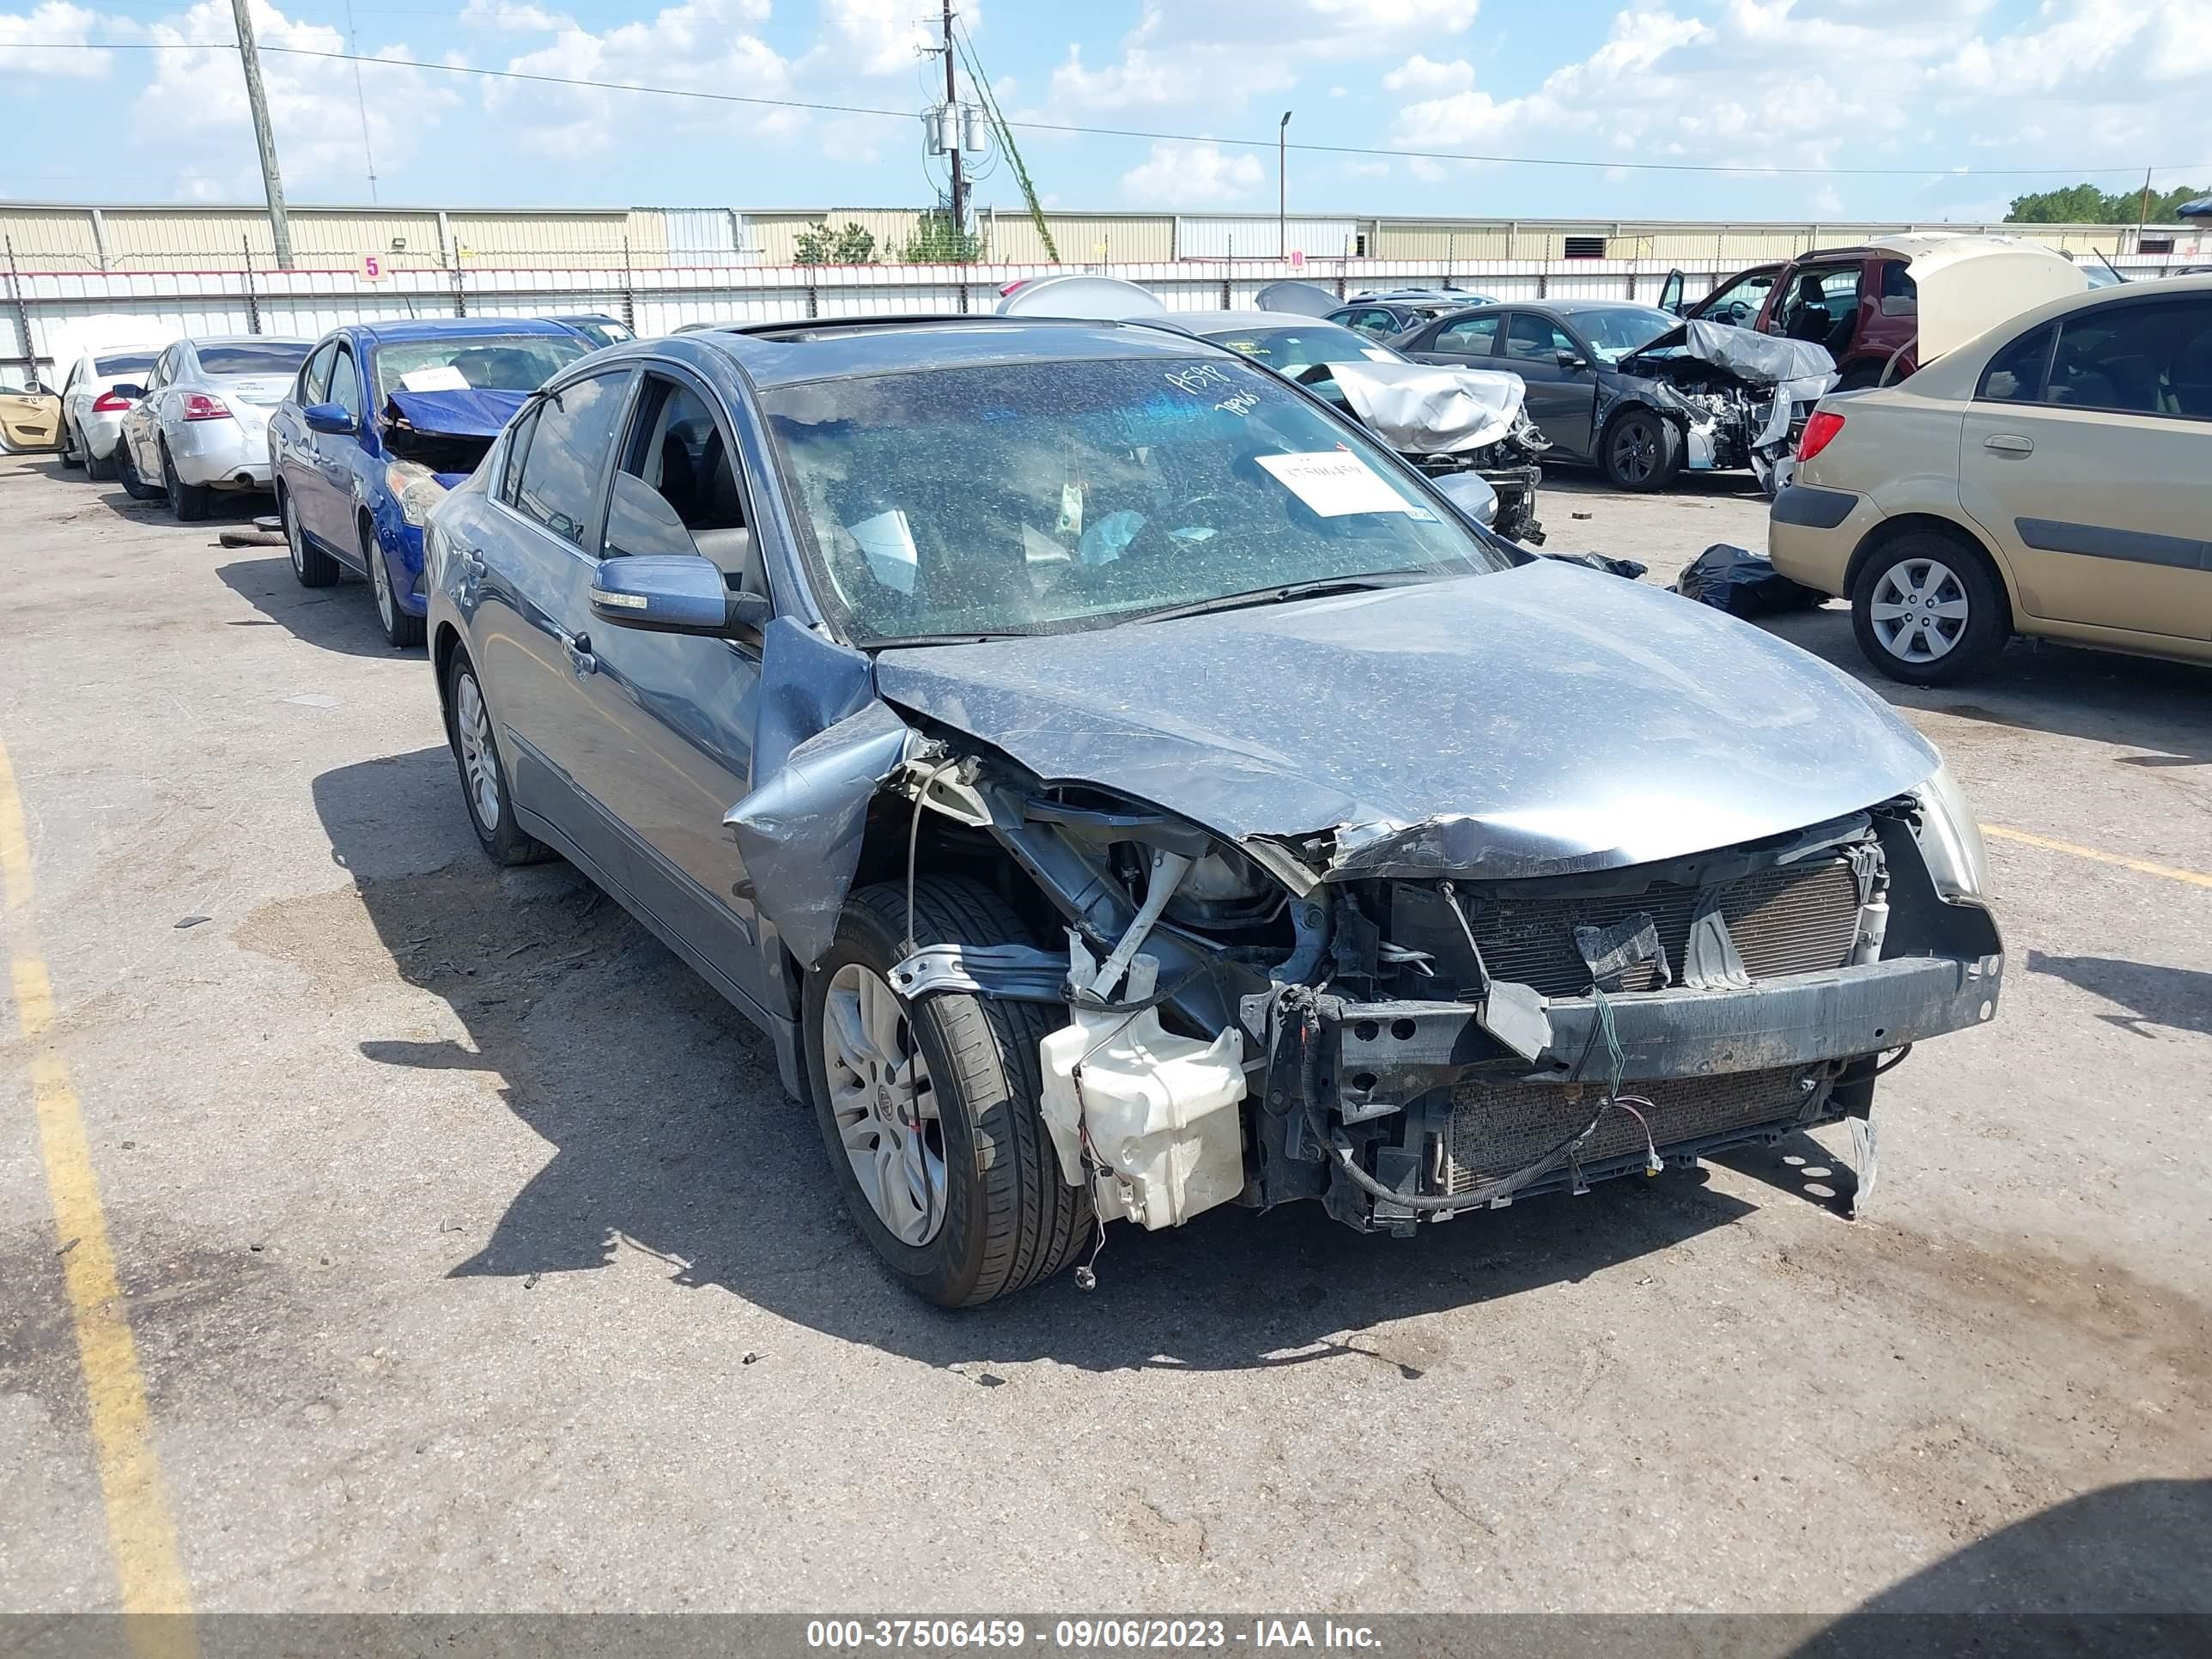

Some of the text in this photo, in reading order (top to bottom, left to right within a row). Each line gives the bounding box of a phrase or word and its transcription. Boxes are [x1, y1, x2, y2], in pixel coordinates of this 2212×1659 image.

[366, 258, 379, 276] 5
[1291, 252, 1302, 265] 10
[1164, 365, 1231, 395] A598
